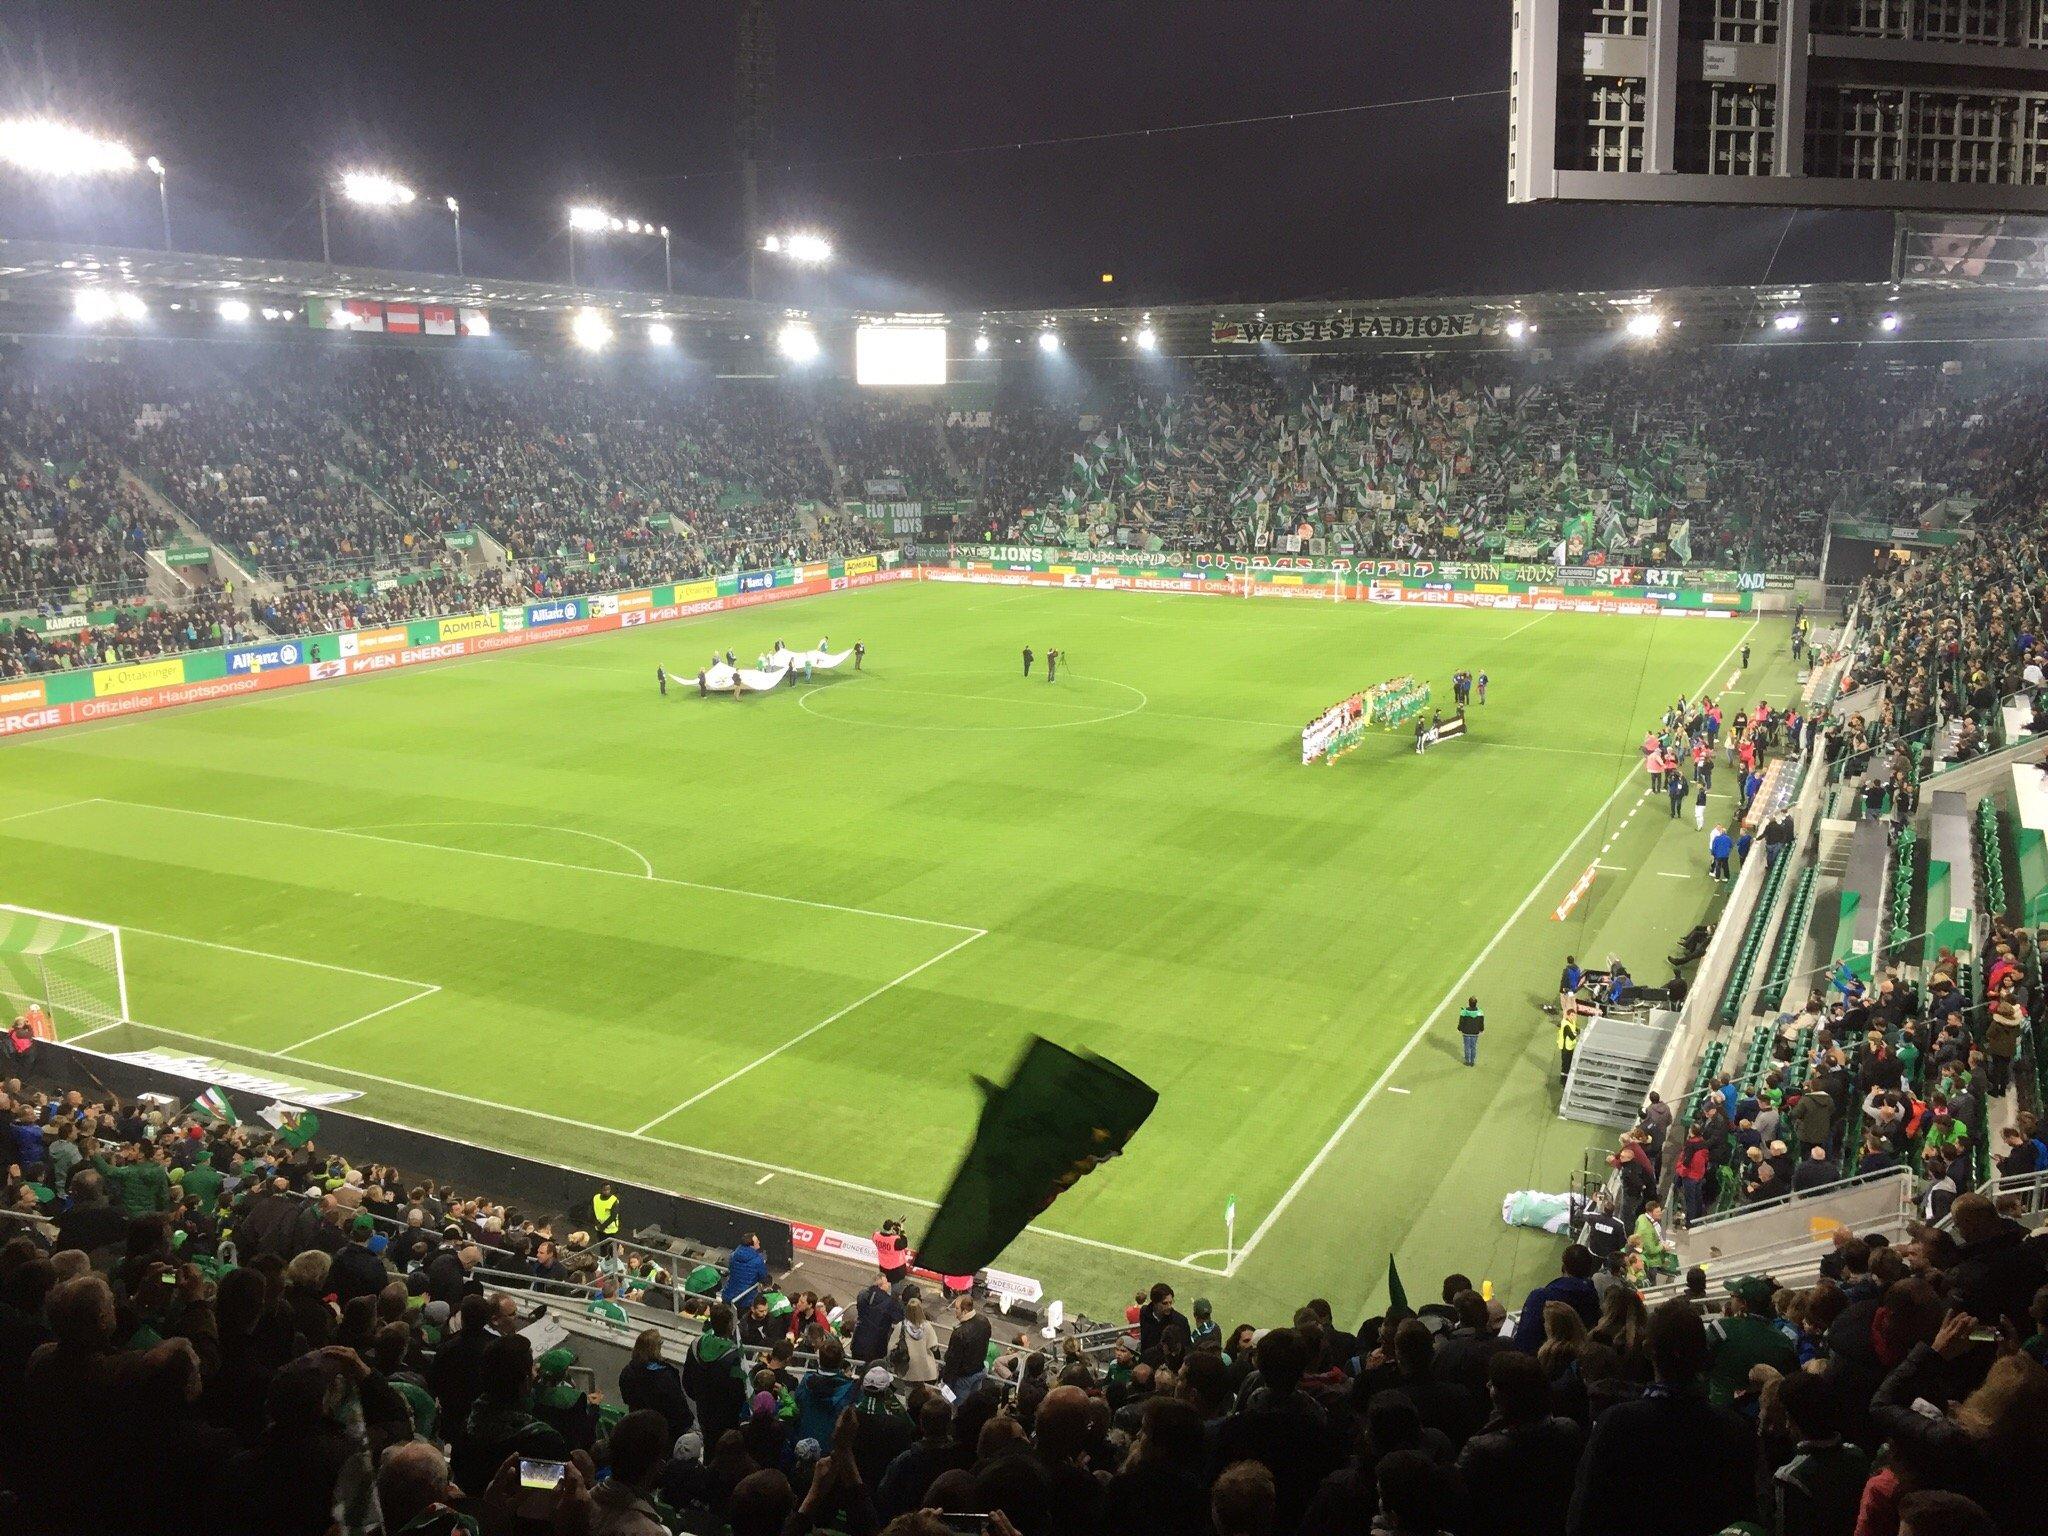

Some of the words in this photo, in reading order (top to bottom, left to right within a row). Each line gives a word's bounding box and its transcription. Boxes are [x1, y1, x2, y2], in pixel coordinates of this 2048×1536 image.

[1242, 315, 1466, 342] WESTSTADION
[888, 502, 922, 518] TOWN
[893, 517, 923, 534] BOYS
[989, 546, 1043, 562] LIONS
[874, 568, 913, 582] ENERGIE
[1135, 578, 1192, 590] ENERGIE
[1407, 591, 1449, 602] WIEN
[1453, 592, 1521, 606] ENERGIE
[532, 608, 564, 623] Allianz
[651, 607, 678, 621] WIEN
[681, 598, 724, 616] ENERGIE
[443, 618, 497, 636] ADMIRAL
[353, 653, 397, 672] WIEN
[401, 642, 465, 664] ENERGIE
[477, 635, 523, 650] Offizieller
[526, 624, 590, 642] Hauptsponsor
[118, 667, 178, 684] Ottakringer
[82, 693, 155, 717] Offizieller
[159, 677, 260, 704] Hauptsponsor
[842, 1242, 878, 1258] BUNDESLI
[987, 1278, 1026, 1293] UNDESLIGA
